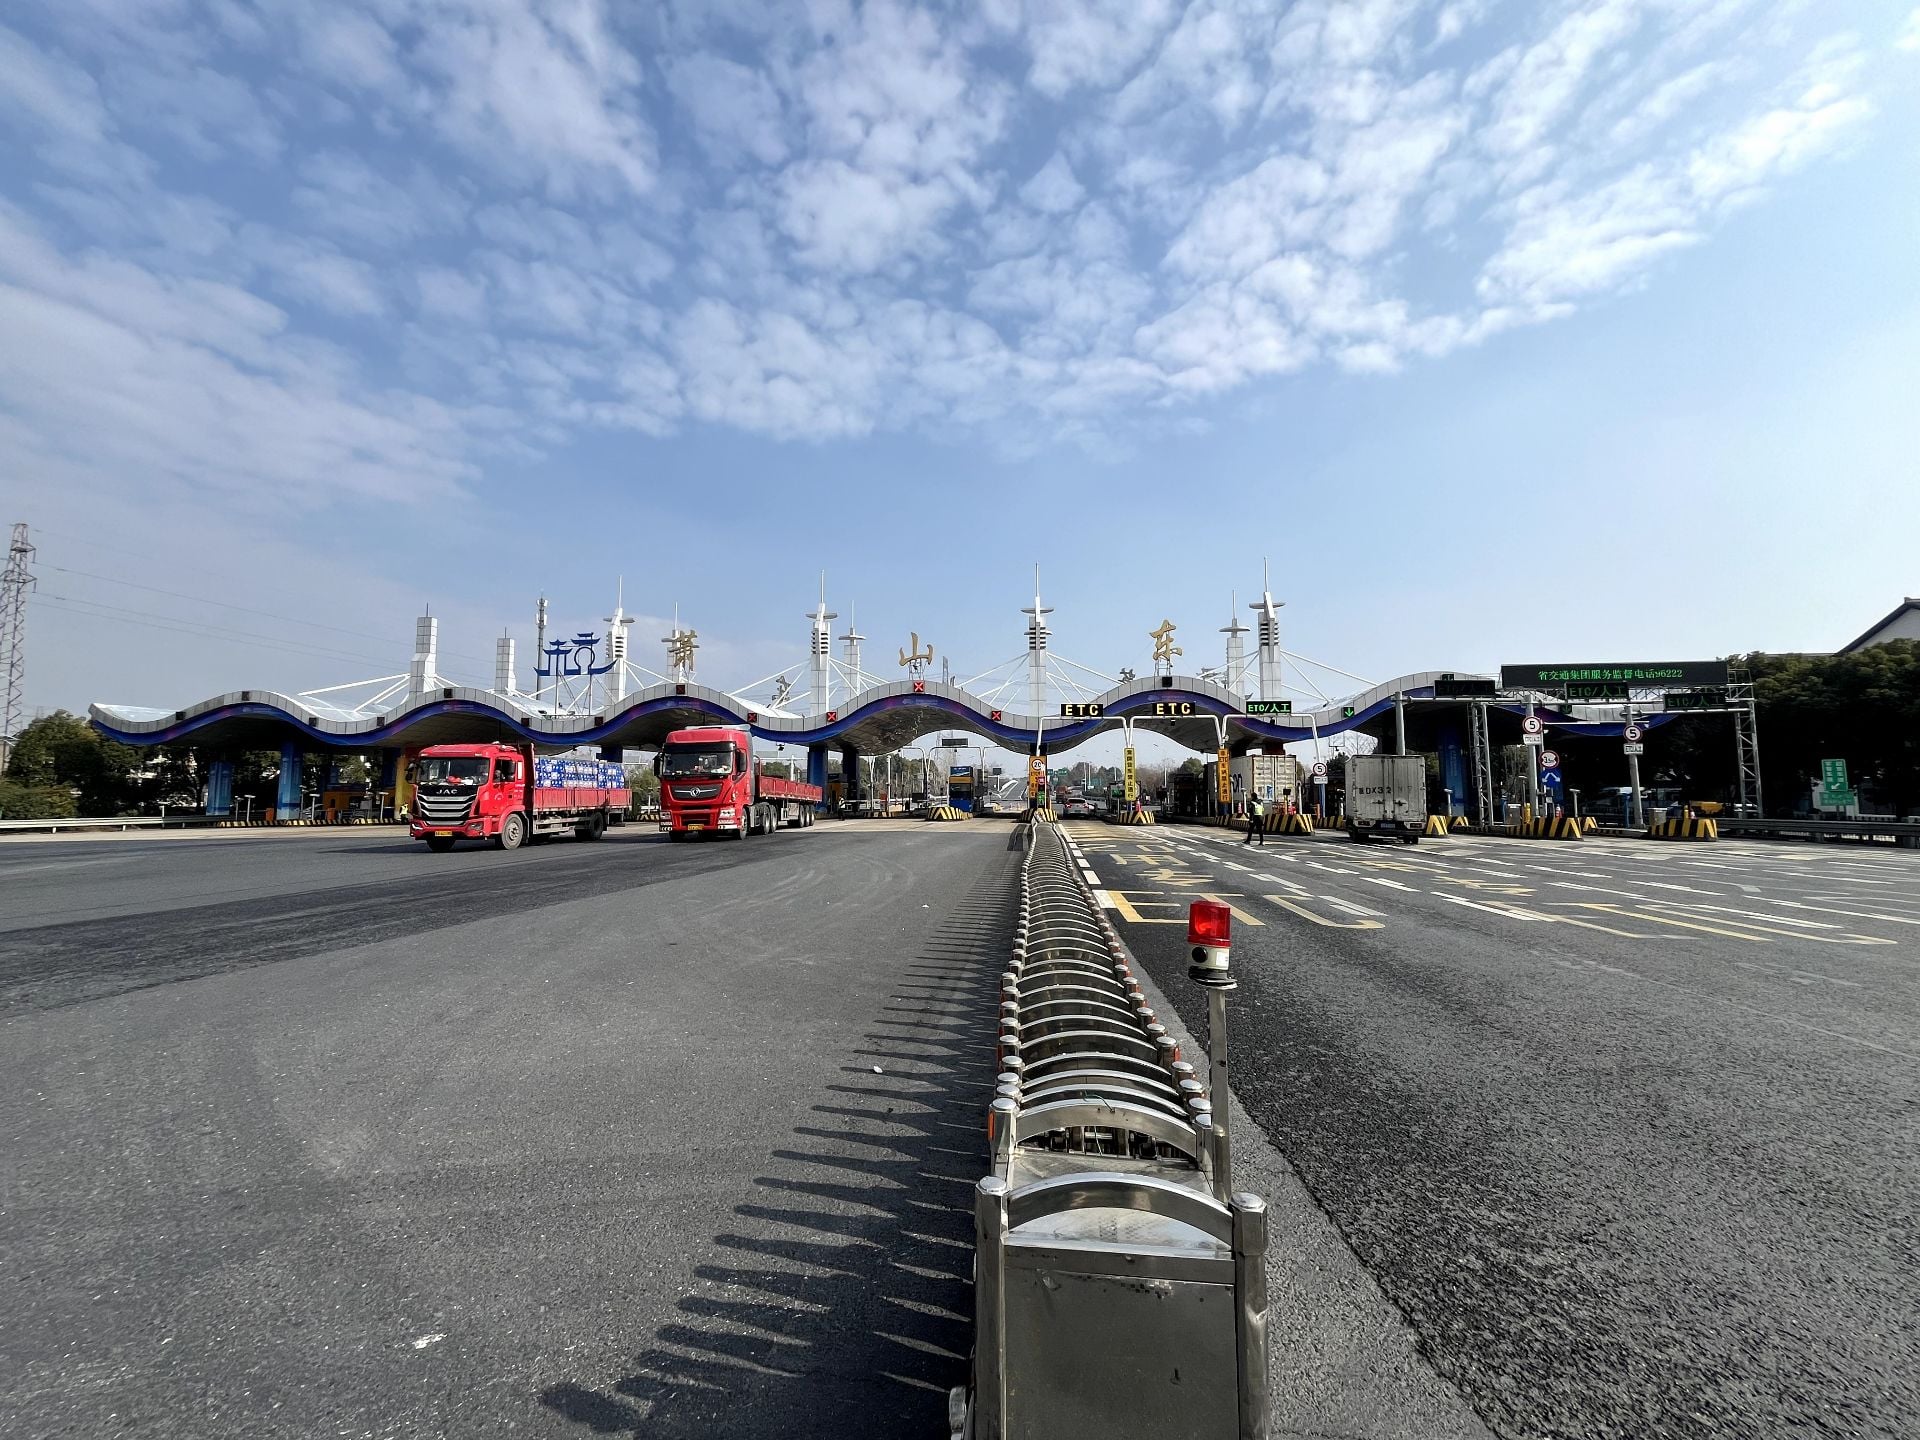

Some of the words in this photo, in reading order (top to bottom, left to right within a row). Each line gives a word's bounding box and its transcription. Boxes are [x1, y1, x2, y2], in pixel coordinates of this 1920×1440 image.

[1065, 705, 1099, 716] ETC
[1156, 703, 1191, 714] ETC
[1248, 703, 1290, 713] ETC/人工
[1530, 721, 1536, 729] 5
